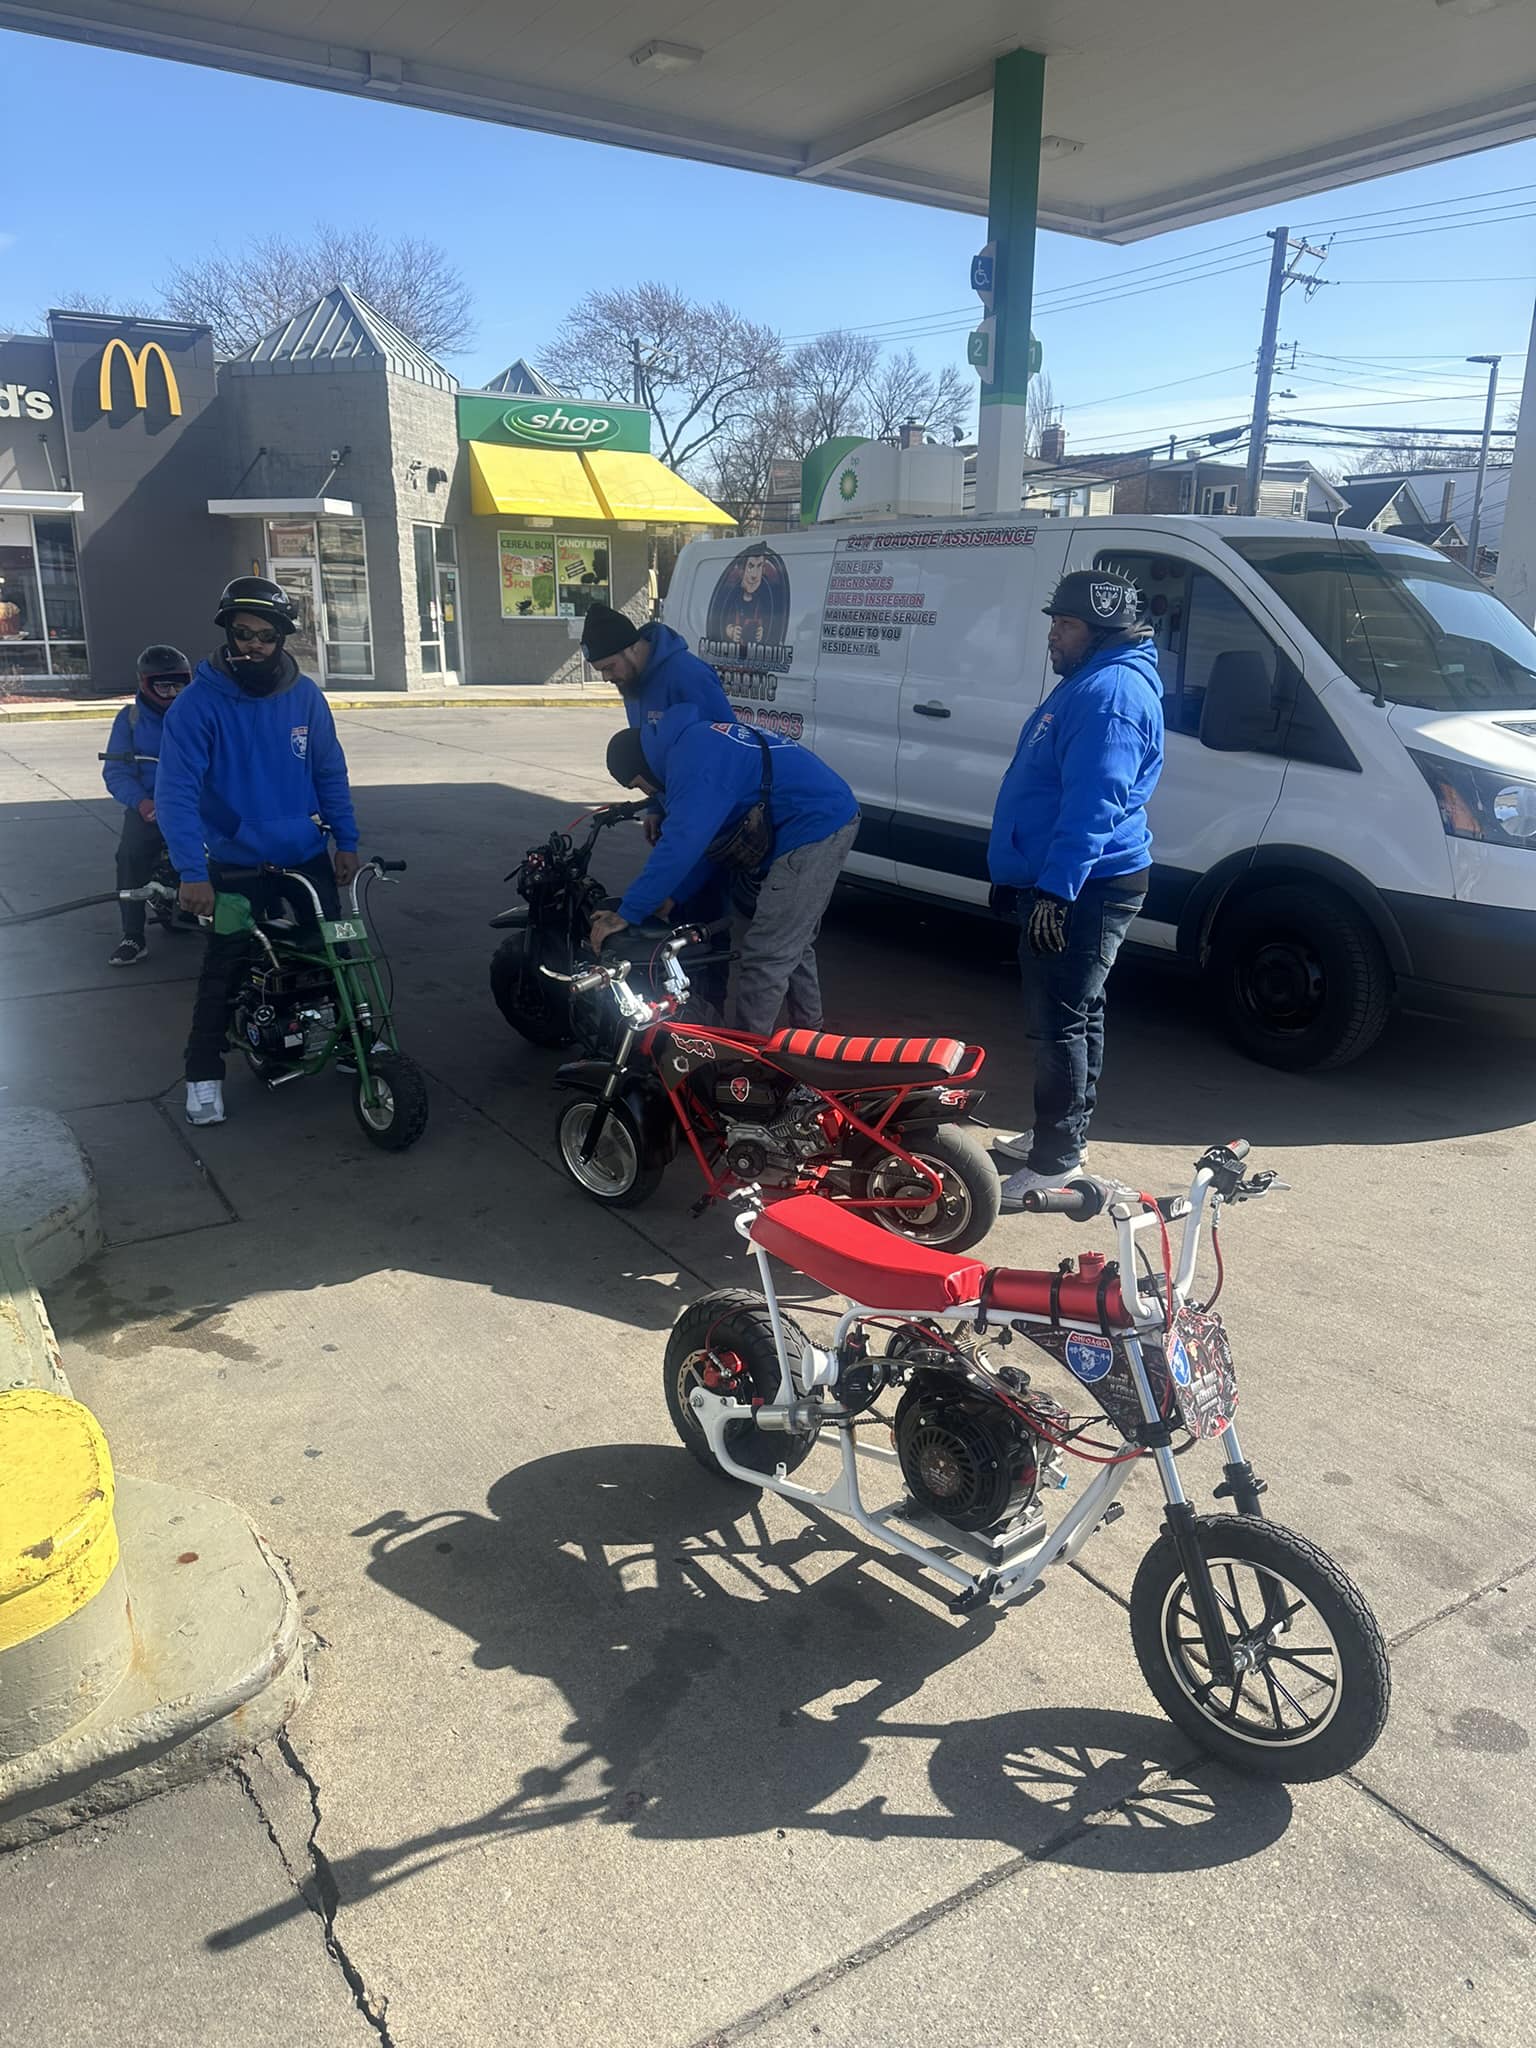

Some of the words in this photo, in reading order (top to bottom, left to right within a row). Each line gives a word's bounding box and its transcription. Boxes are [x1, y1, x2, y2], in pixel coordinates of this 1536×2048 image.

[973, 338, 984, 357] 2
[530, 407, 609, 441] shop
[501, 540, 533, 549] CEREAL
[534, 541, 553, 550] BOX
[558, 539, 586, 549] CANDY
[586, 541, 608, 550] BARS
[874, 530, 943, 549] ROADSIDE
[941, 526, 1038, 547] ASSISTANCE
[560, 547, 567, 560] 2
[503, 572, 513, 589] 3
[514, 580, 531, 588] FOR
[864, 592, 925, 608] INSPECTION
[824, 608, 892, 623] MAINTENANCE
[892, 609, 937, 626] SERVICE
[823, 624, 838, 638] WE
[838, 625, 865, 639] COME
[866, 626, 880, 640] TO
[880, 626, 902, 641] YOU
[822, 640, 880, 656] RESIDENTIAL
[1071, 1334, 1108, 1347] CHICAGO
